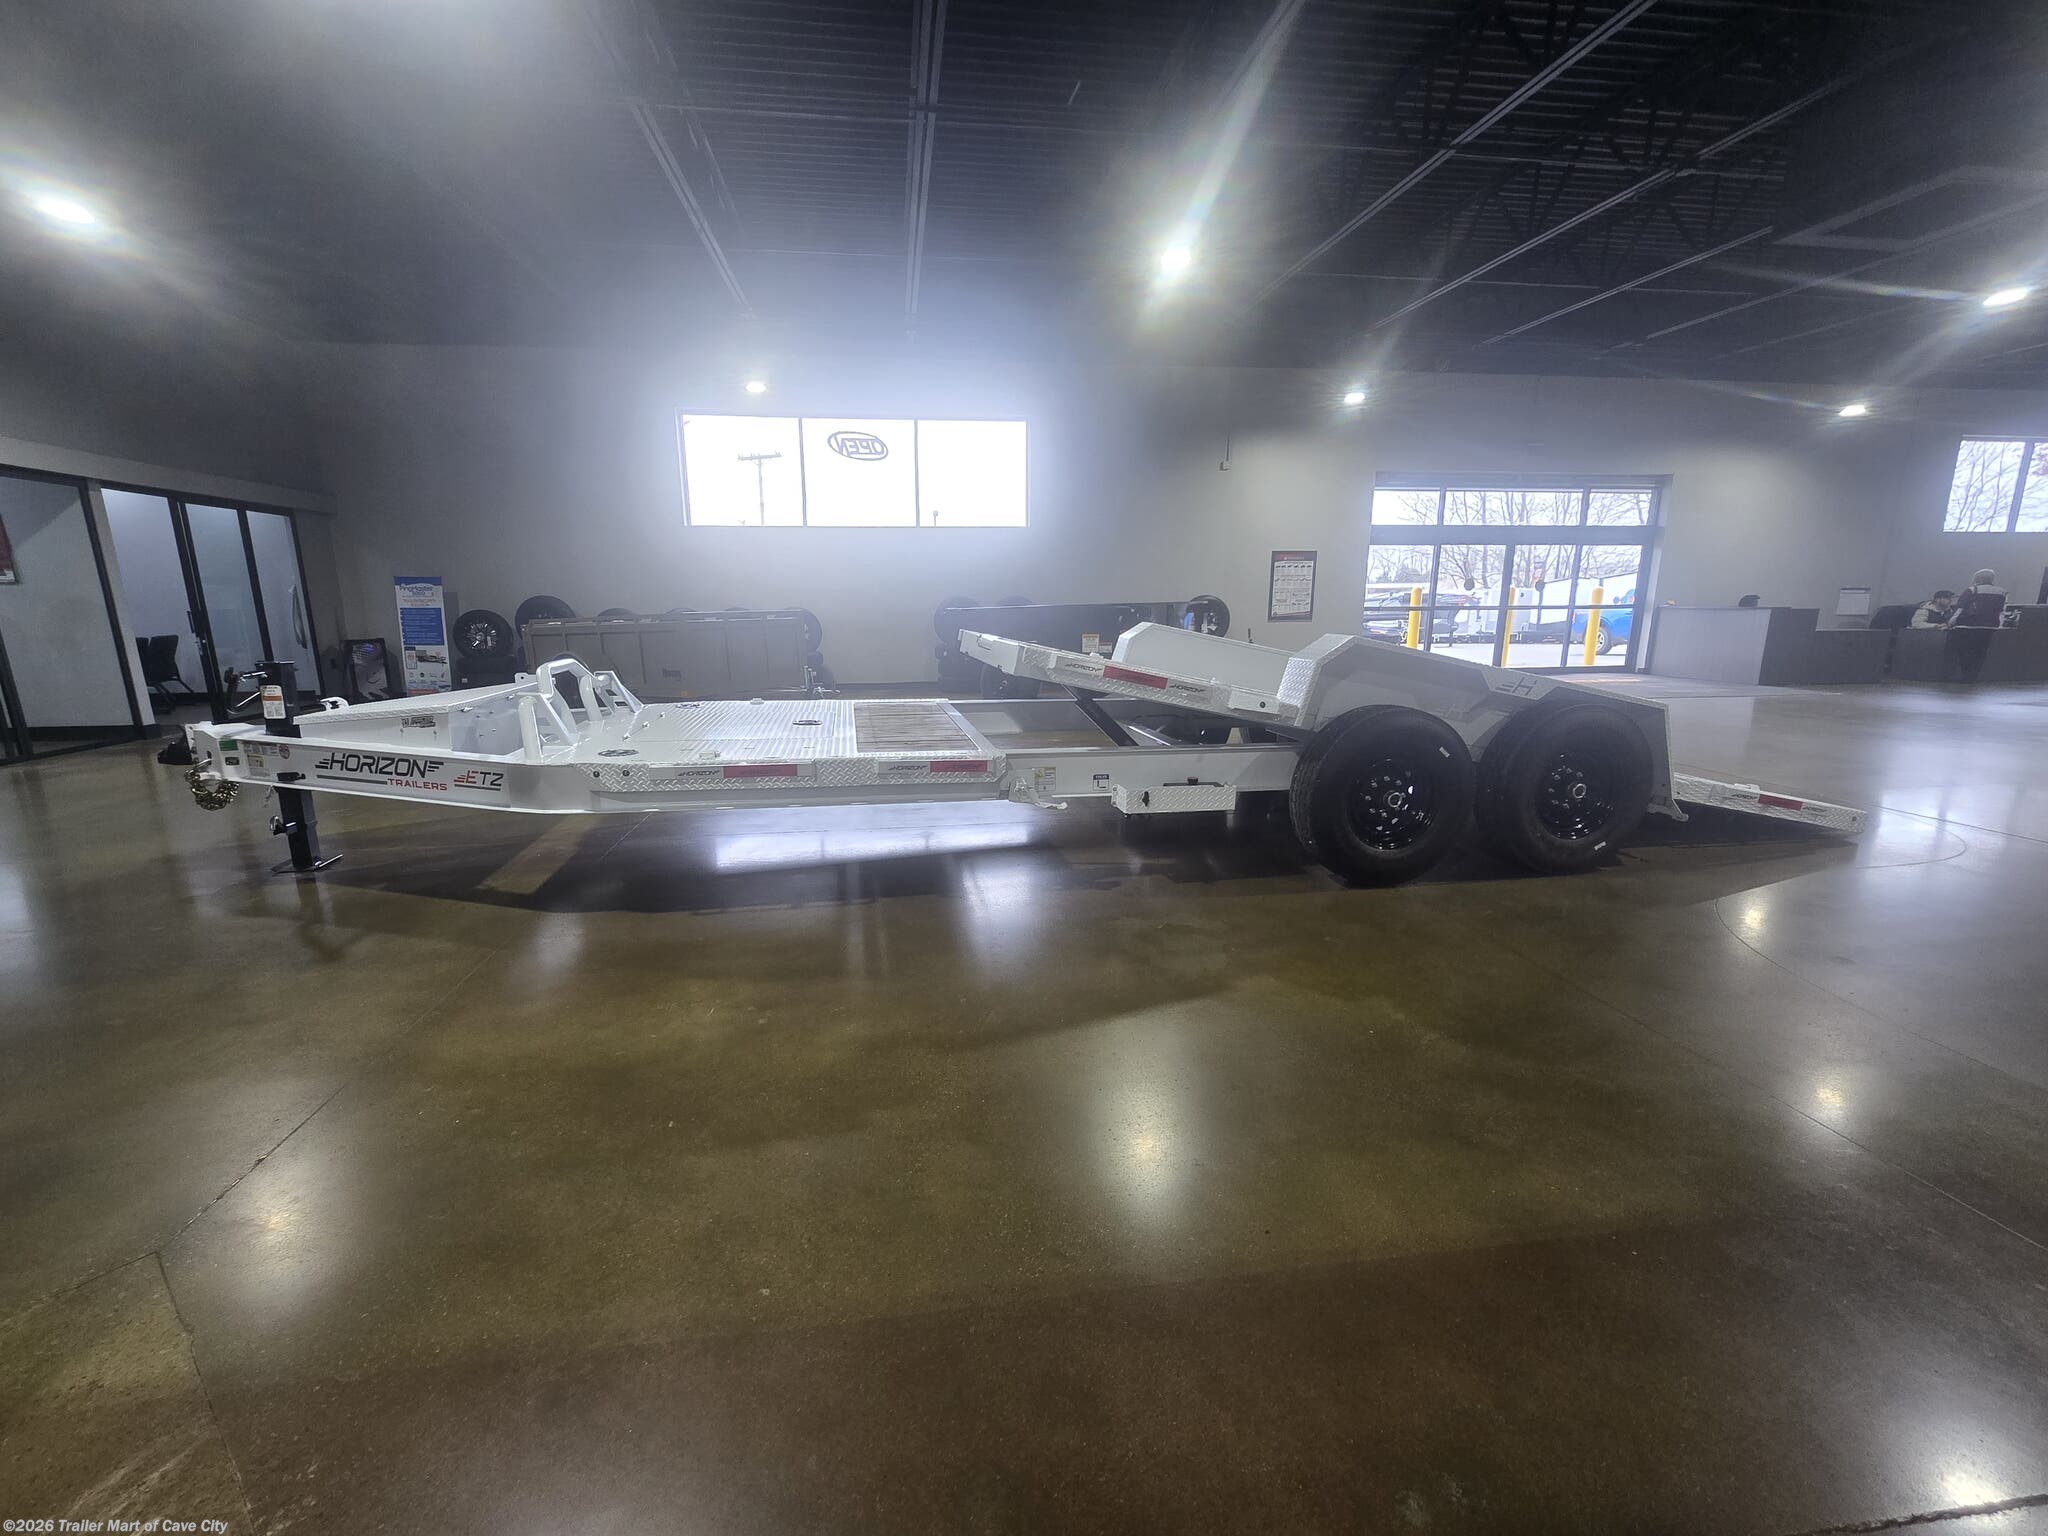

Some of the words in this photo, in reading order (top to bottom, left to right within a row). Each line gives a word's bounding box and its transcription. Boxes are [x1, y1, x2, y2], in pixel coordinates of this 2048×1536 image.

[319, 753, 440, 779] HORIZON
[387, 778, 448, 791] TRAILERS
[459, 769, 505, 787] ETZ
